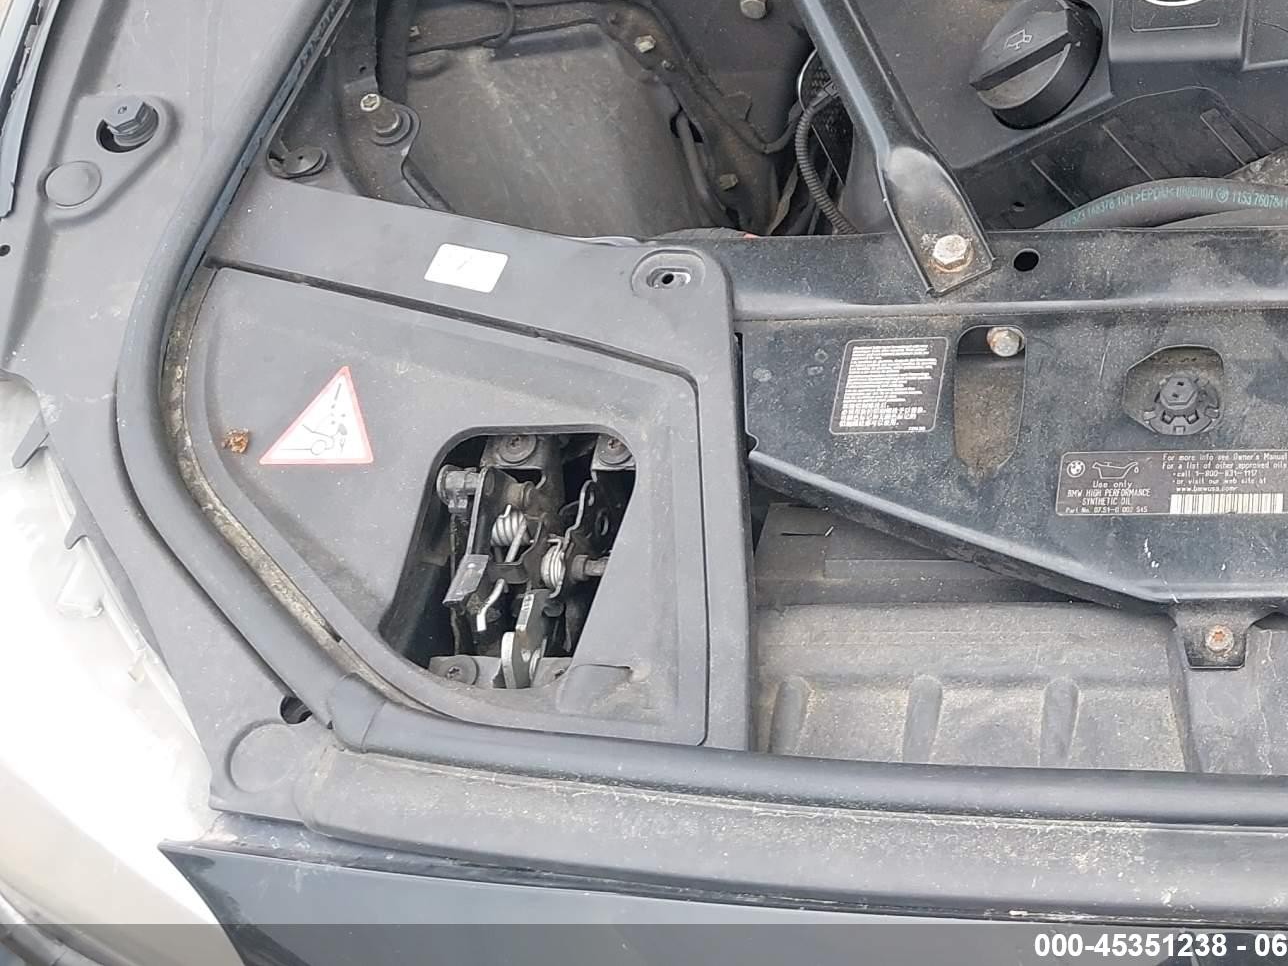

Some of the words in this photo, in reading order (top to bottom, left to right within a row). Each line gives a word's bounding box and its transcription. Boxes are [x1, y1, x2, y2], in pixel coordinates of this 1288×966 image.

[1162, 453, 1175, 461] For
[1233, 452, 1260, 461] Owner's
[1263, 452, 1288, 461] Manual
[1162, 462, 1174, 470] For
[1186, 461, 1199, 470] list
[1203, 461, 1212, 469] of
[1092, 480, 1108, 488] Use
[1113, 480, 1133, 491] only
[1067, 489, 1083, 497] BMW
[1085, 489, 1102, 497] HIGH
[1104, 488, 1151, 497] PERFORMANCE
[1081, 497, 1118, 506] SYNTHETIC
[1120, 497, 1131, 505] OIL
